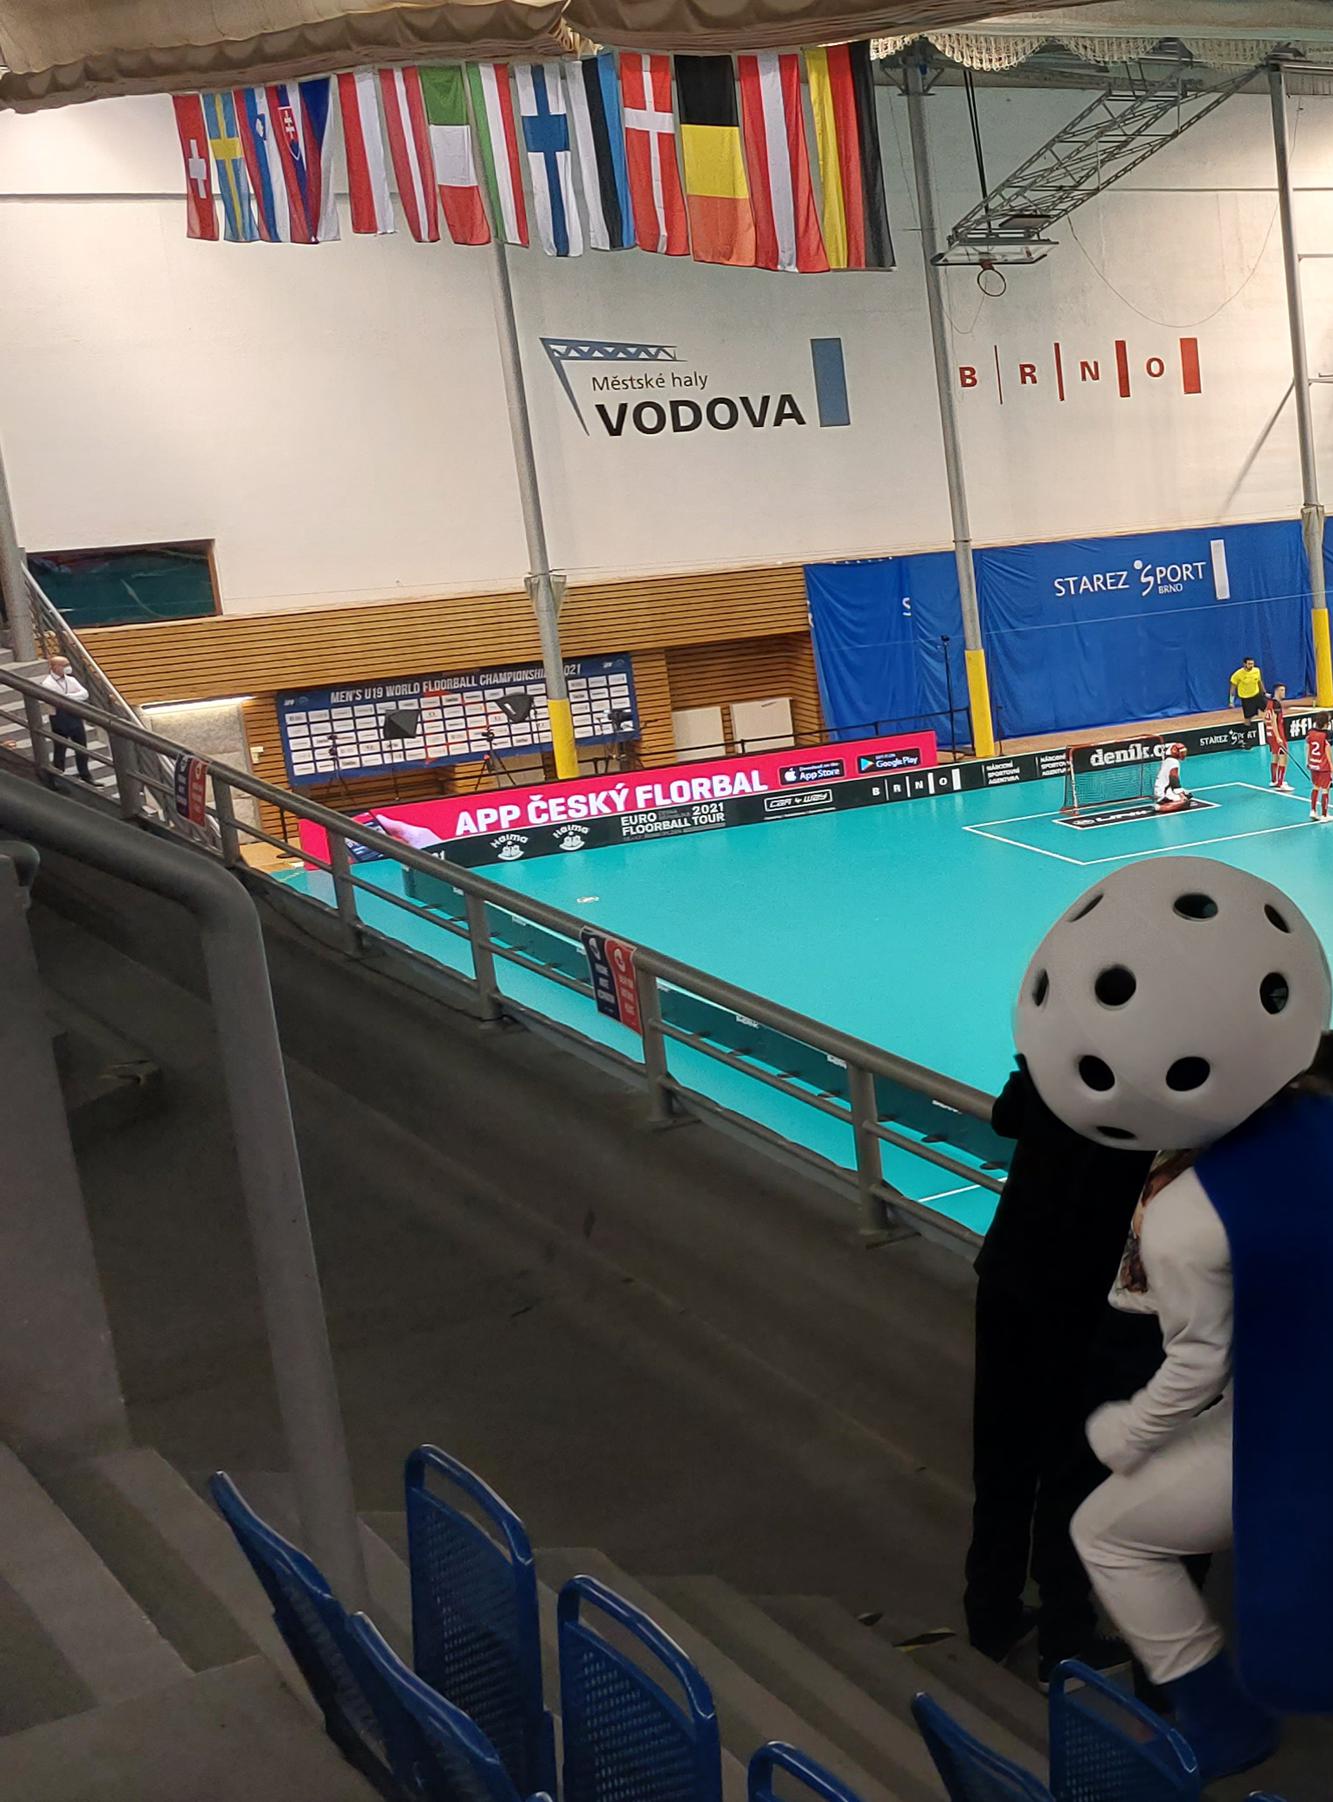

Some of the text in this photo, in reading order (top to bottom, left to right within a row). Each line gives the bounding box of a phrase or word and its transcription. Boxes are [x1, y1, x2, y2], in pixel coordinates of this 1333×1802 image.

[592, 372, 708, 391] Městské haly
[594, 393, 807, 438] VODOVA
[1054, 562, 1206, 597] STAREZ SPORT
[1158, 583, 1183, 594] BRNO
[330, 686, 362, 704] MEN'S
[364, 687, 383, 700] U19
[385, 681, 421, 698] WORLD
[422, 674, 478, 693] FLOORBALL
[479, 667, 548, 685] CHAMPIONSHI
[1310, 742, 1321, 756] 2
[876, 757, 902, 769] Google
[902, 755, 918, 766] Play
[799, 768, 840, 782] App Store
[456, 770, 768, 836] APP ČESKÝ FLORBAL
[620, 812, 657, 827] EURO
[692, 802, 725, 817] 2021
[622, 817, 691, 837] FLOORBALL
[692, 812, 725, 828] TOUR
